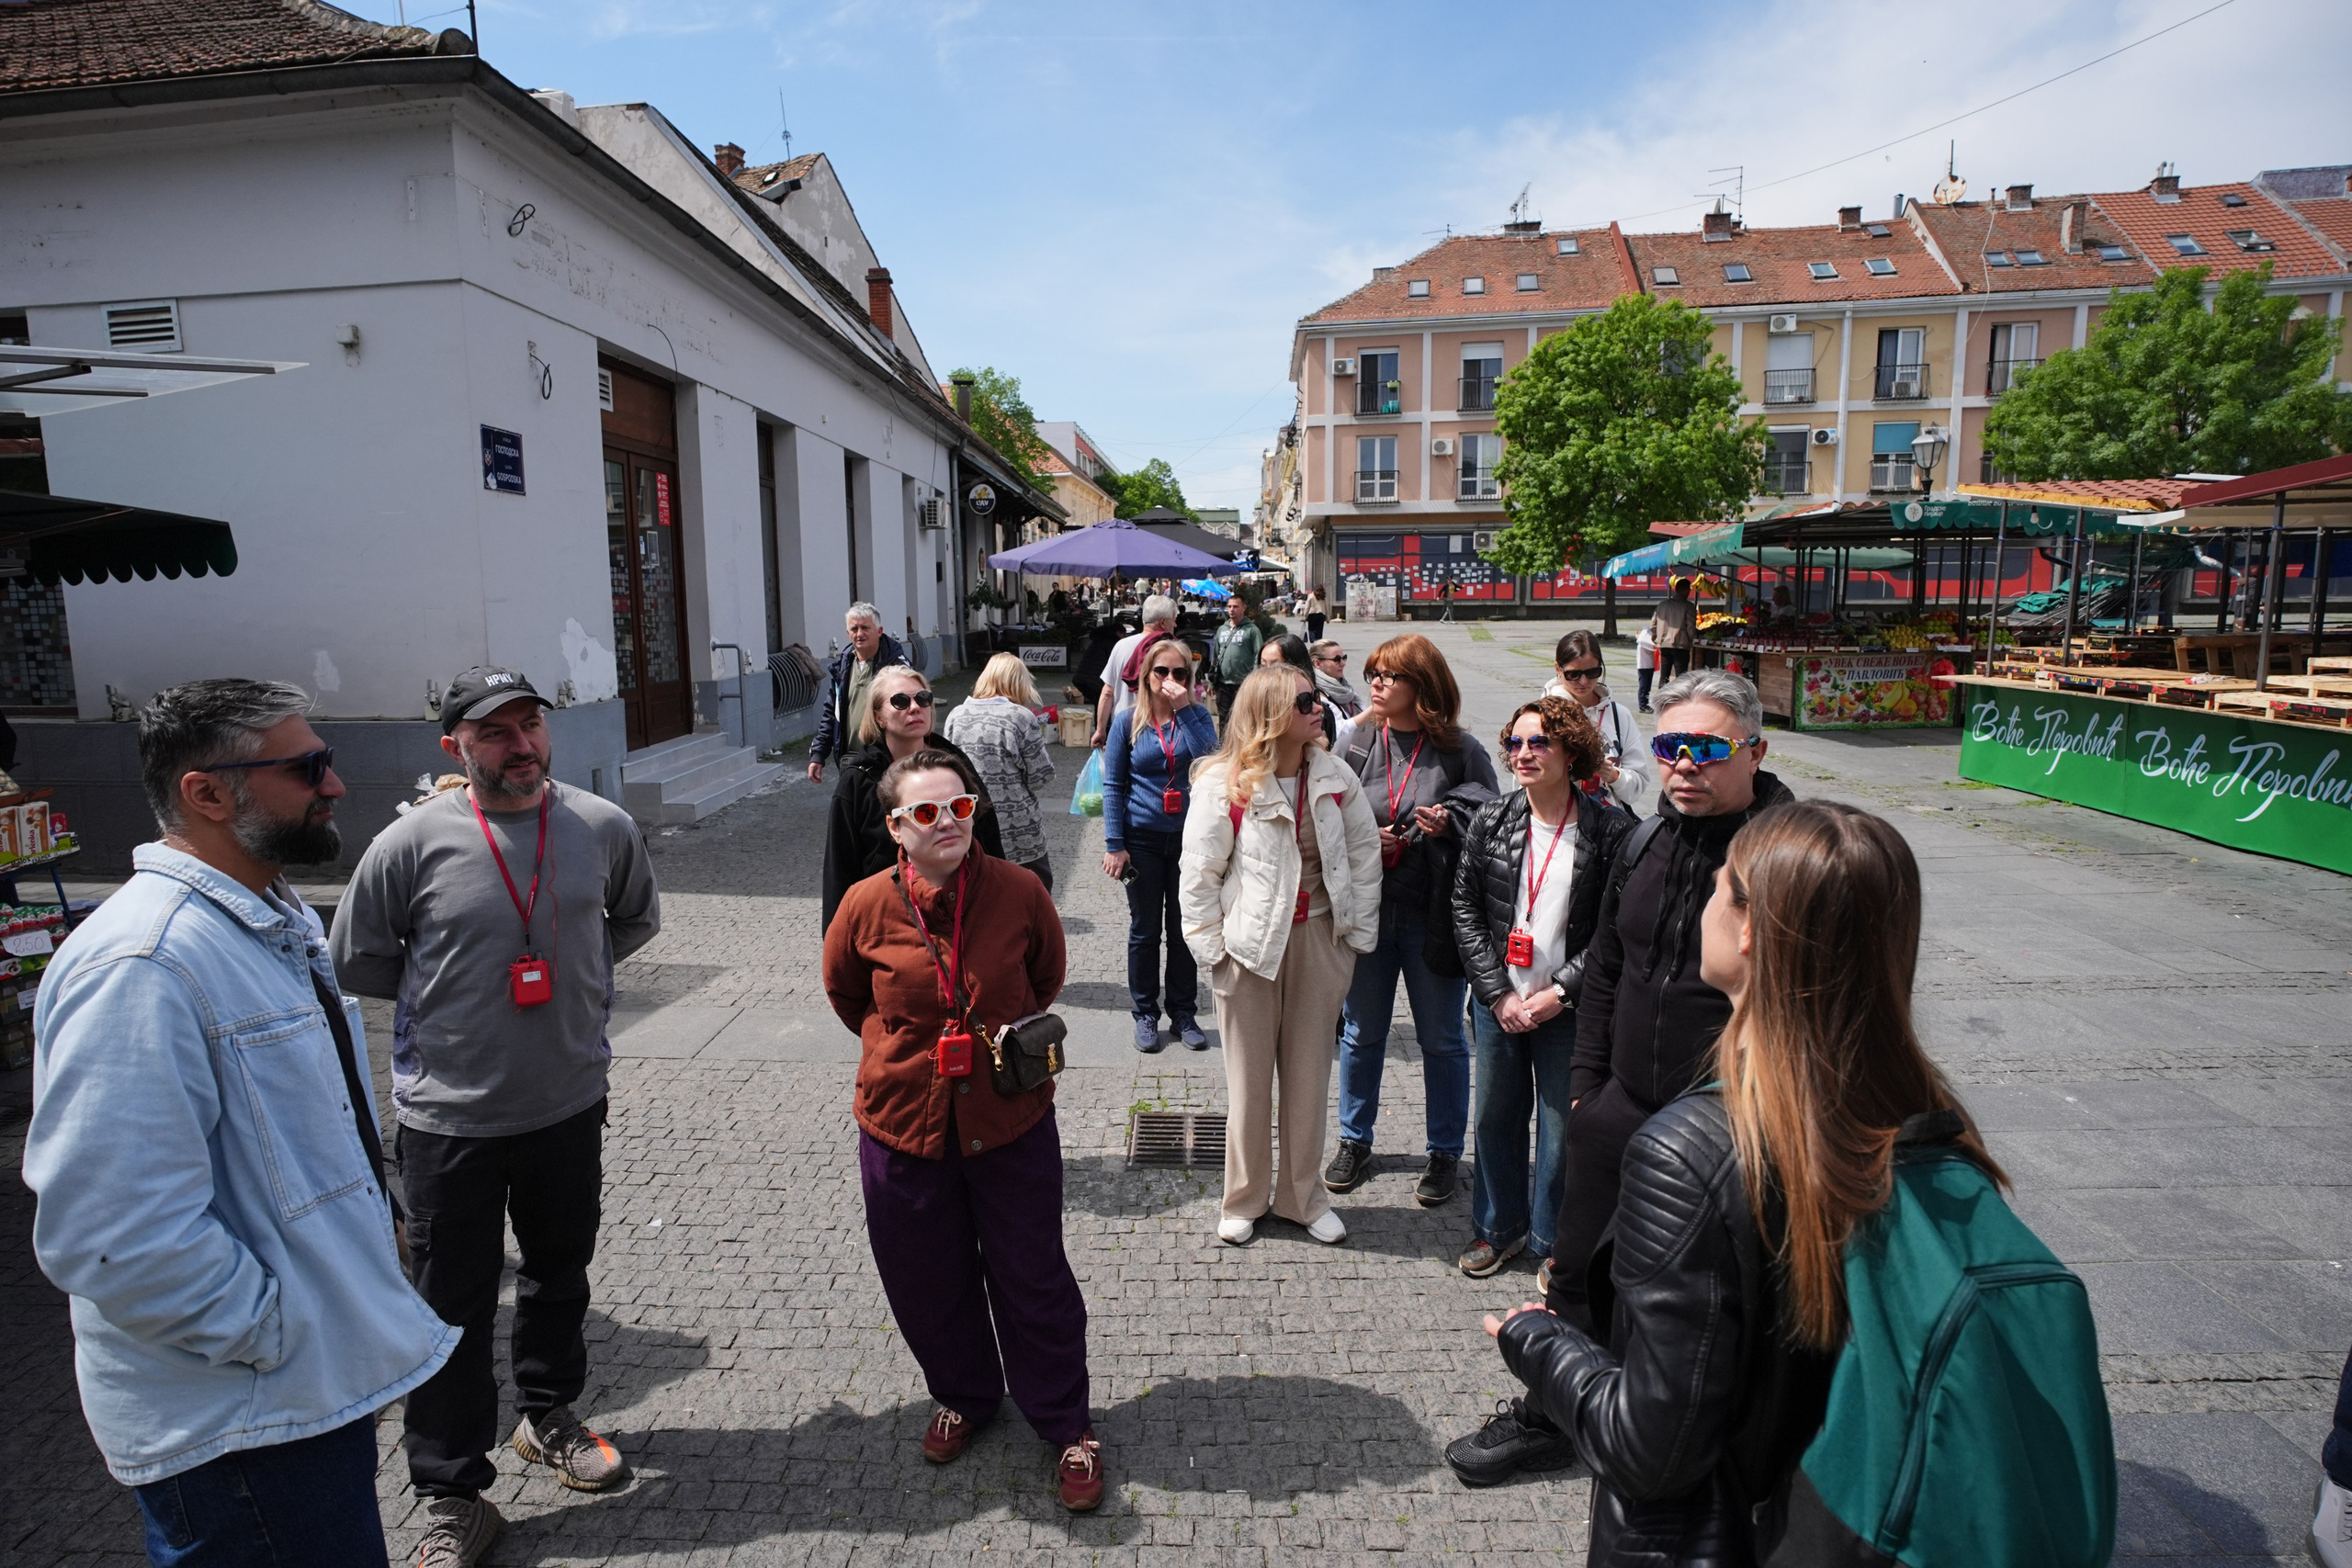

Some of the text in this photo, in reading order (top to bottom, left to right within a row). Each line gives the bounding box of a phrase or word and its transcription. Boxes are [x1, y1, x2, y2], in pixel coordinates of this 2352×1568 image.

[495, 445, 520, 457] ГОСПОДСКА
[497, 471, 522, 484] GOSPODSKA
[1023, 649, 1061, 662] Coca-Cola
[1827, 655, 1925, 668] УВЕК СВЕЖЕ ВОЋЕ!
[484, 672, 514, 687] HPNY
[1847, 669, 1905, 680] ПАВЛОВИЋ
[1972, 700, 2124, 775] Воће Перовић
[2135, 726, 2352, 822] Воће Перови
[13, 936, 44, 954] 250
